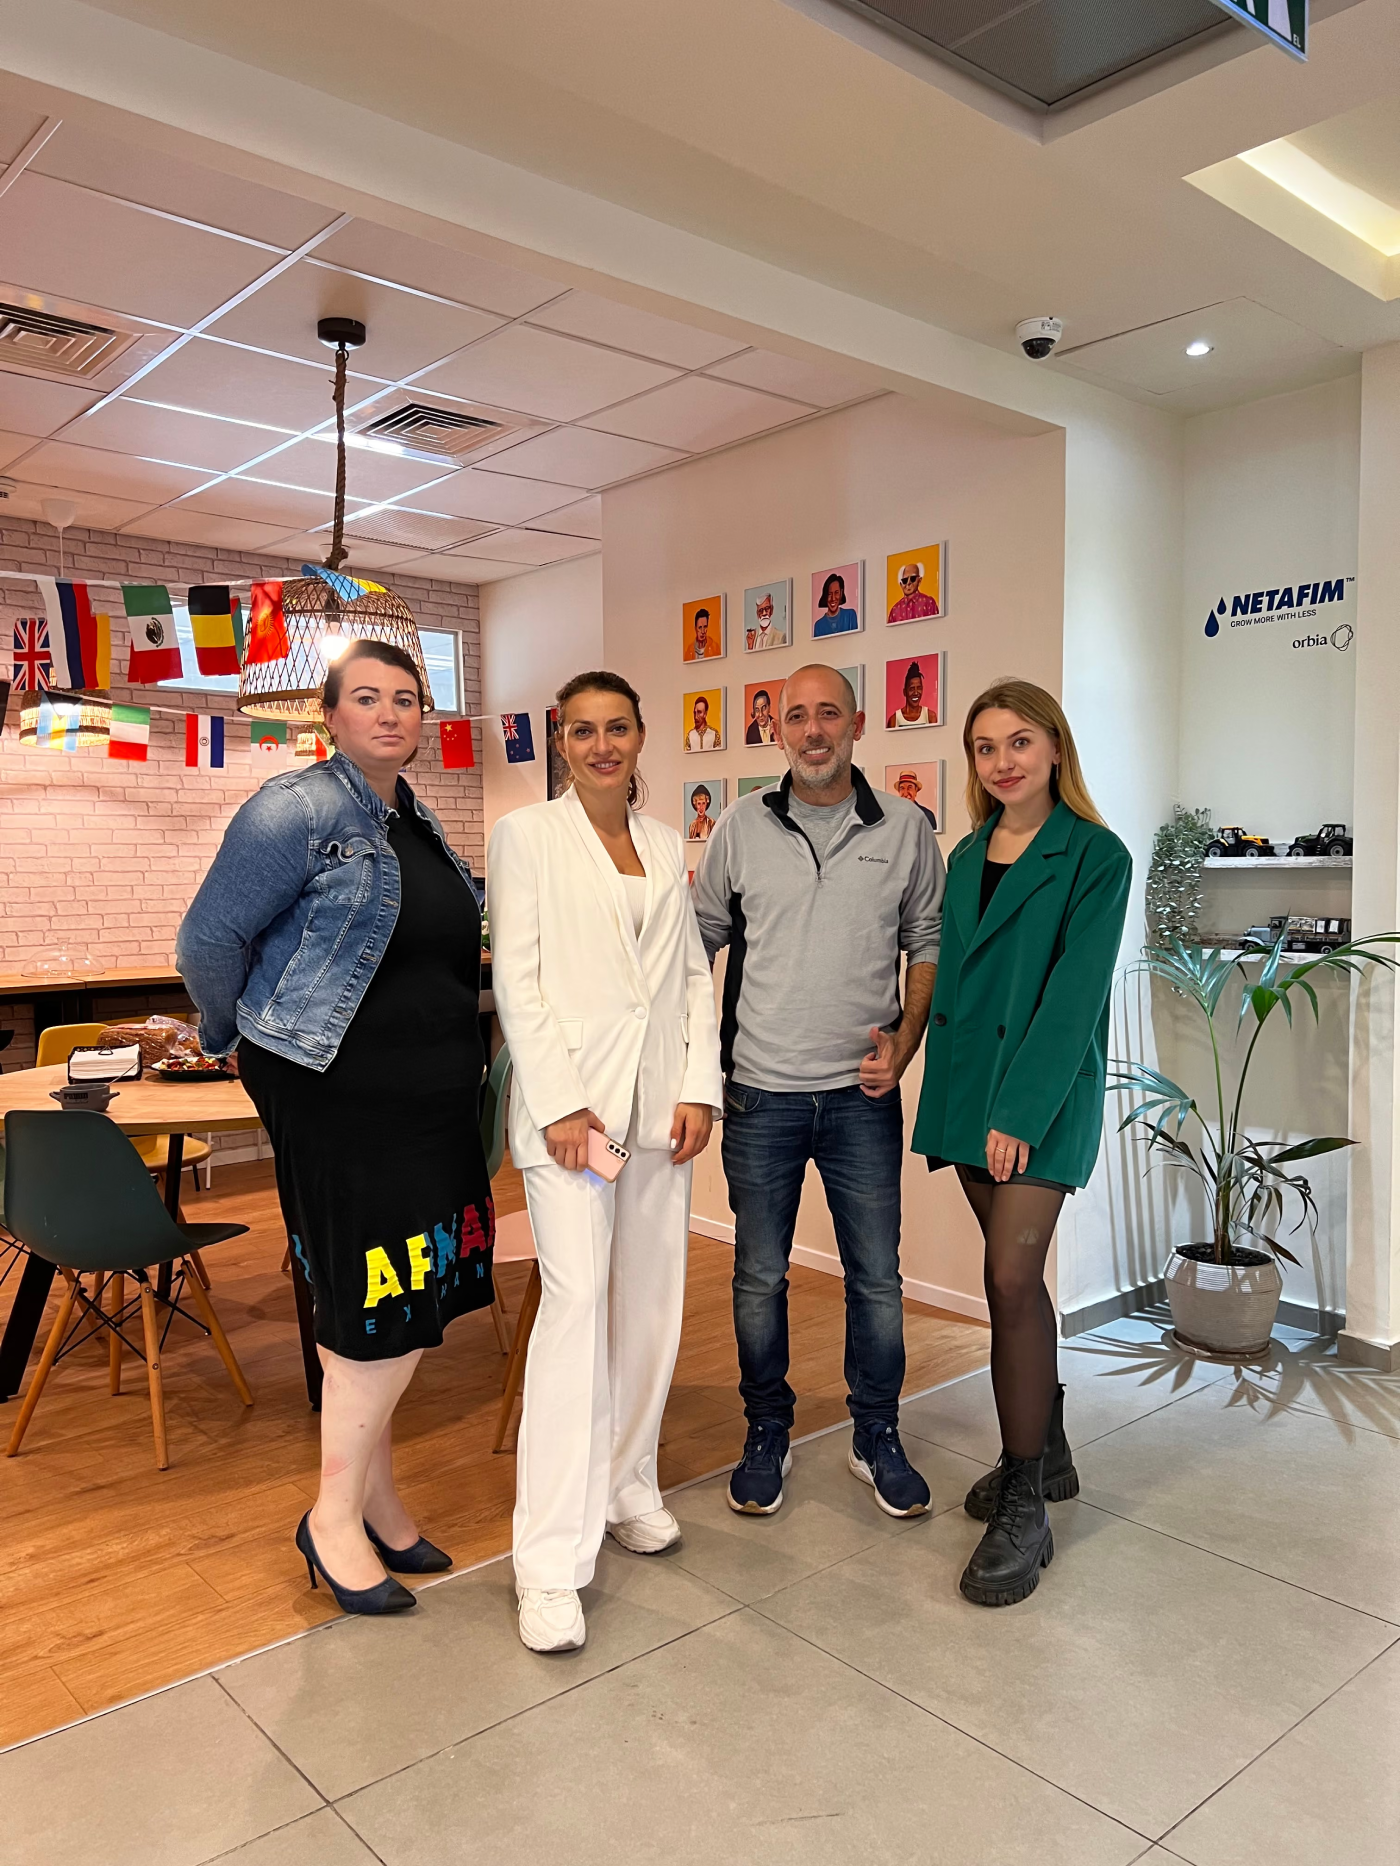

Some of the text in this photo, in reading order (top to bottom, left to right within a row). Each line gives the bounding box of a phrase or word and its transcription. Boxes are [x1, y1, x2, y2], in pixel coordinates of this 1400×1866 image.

[1230, 609, 1317, 627] GROW MORE WITH LESS
[1292, 634, 1328, 648] orbia
